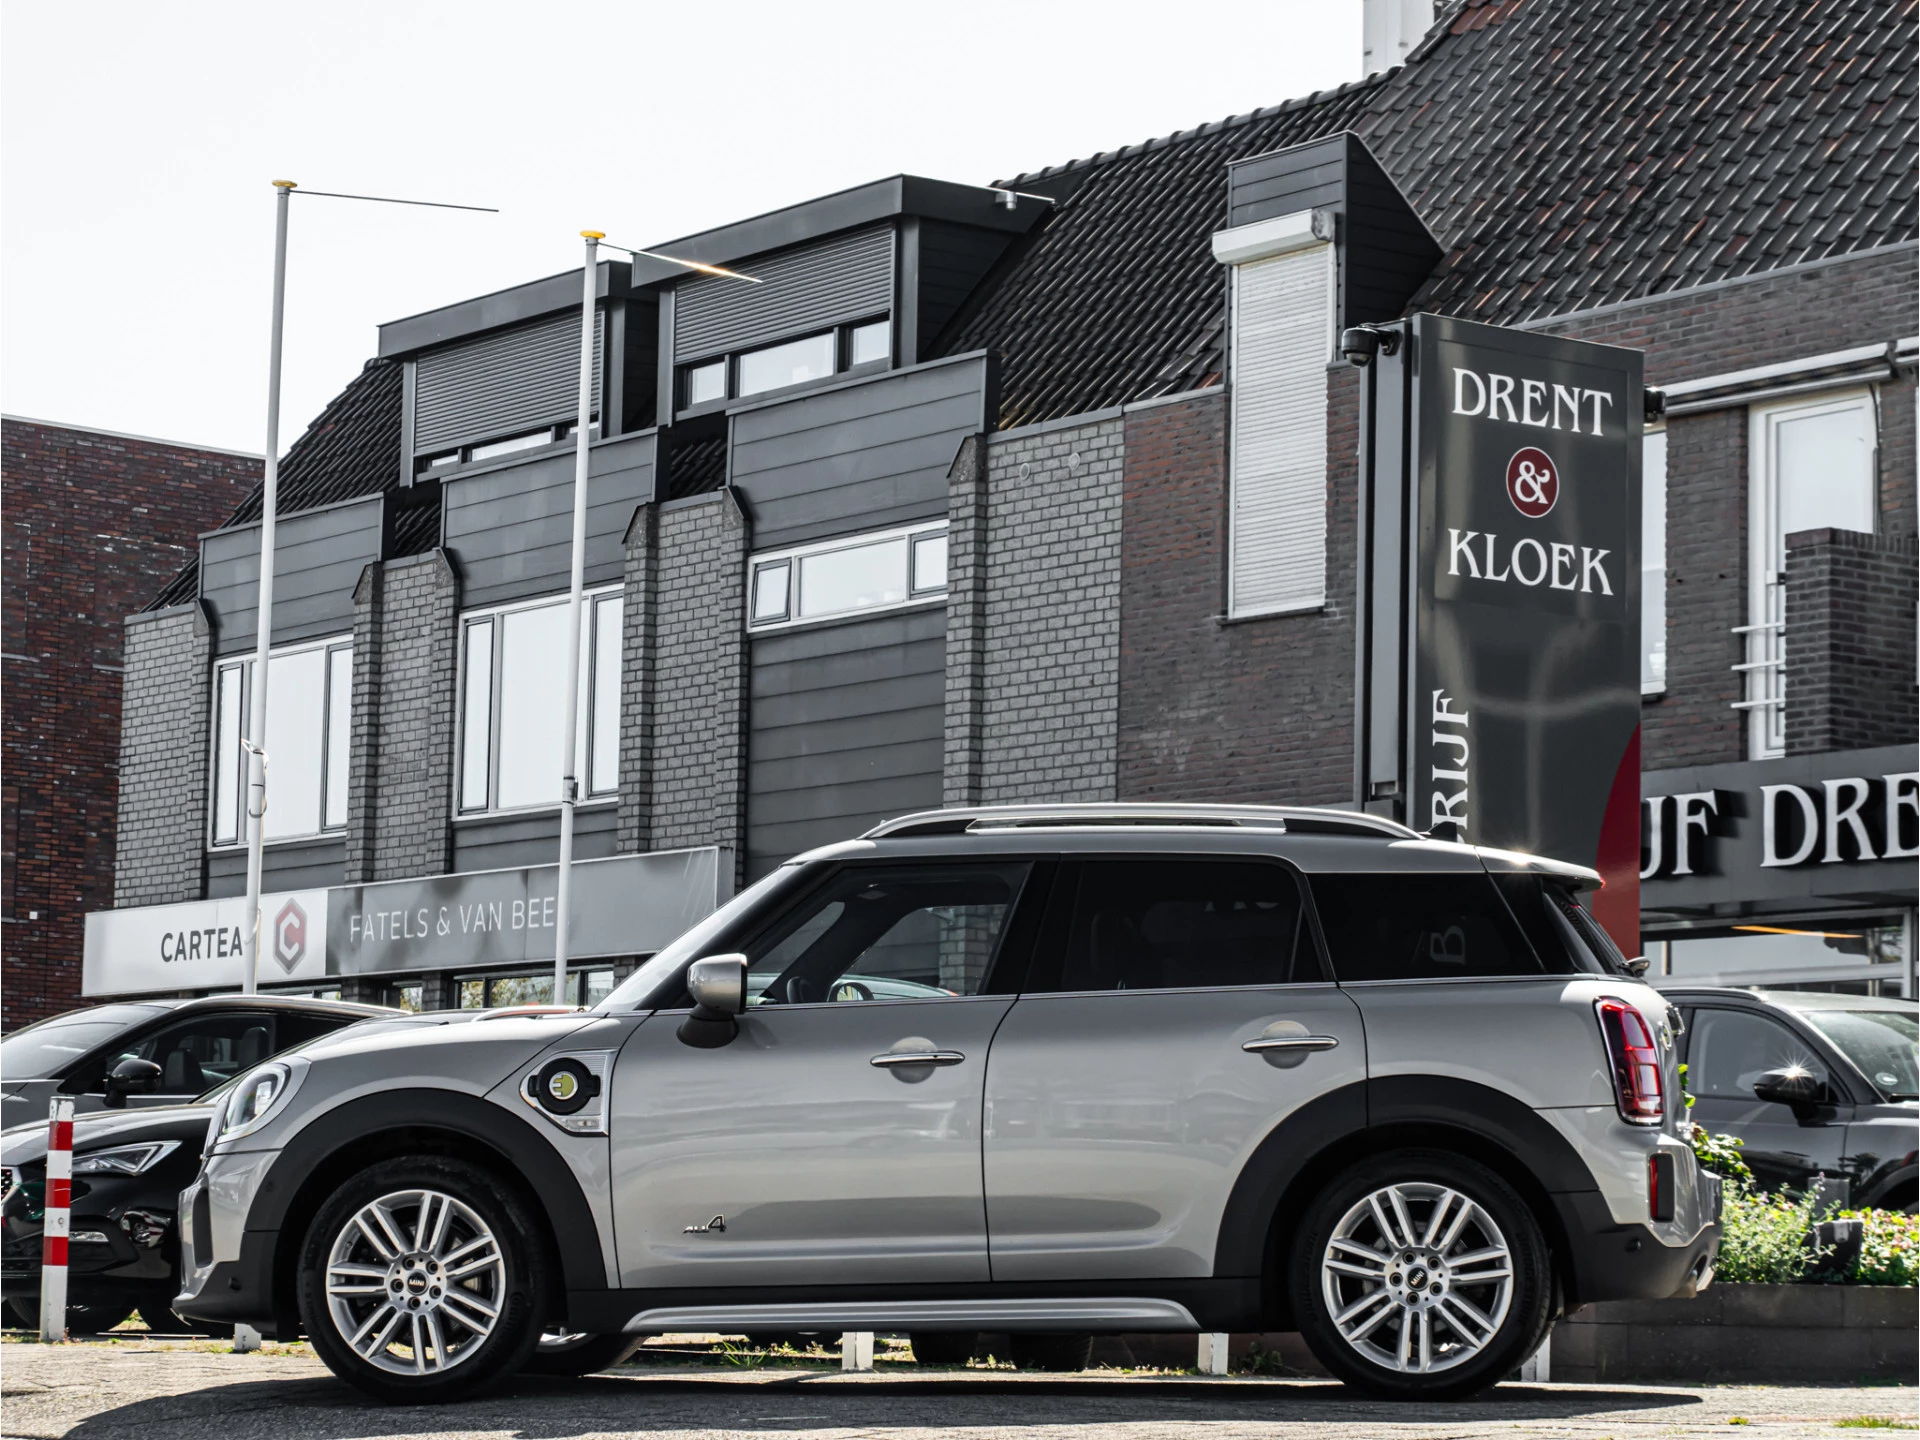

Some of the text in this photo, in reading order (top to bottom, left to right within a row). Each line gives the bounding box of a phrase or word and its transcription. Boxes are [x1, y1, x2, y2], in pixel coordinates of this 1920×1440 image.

[1451, 366, 1614, 437] DRENT
[1514, 460, 1551, 505] &
[1447, 527, 1615, 596] KLOEK
[1431, 688, 1469, 835] RIJF
[1759, 771, 1919, 868] DRE
[349, 896, 556, 943] FATELS & VAN BEE
[160, 925, 244, 963] CARTEA
[408, 1278, 426, 1287] MINI
[1410, 1270, 1426, 1287] MINI
